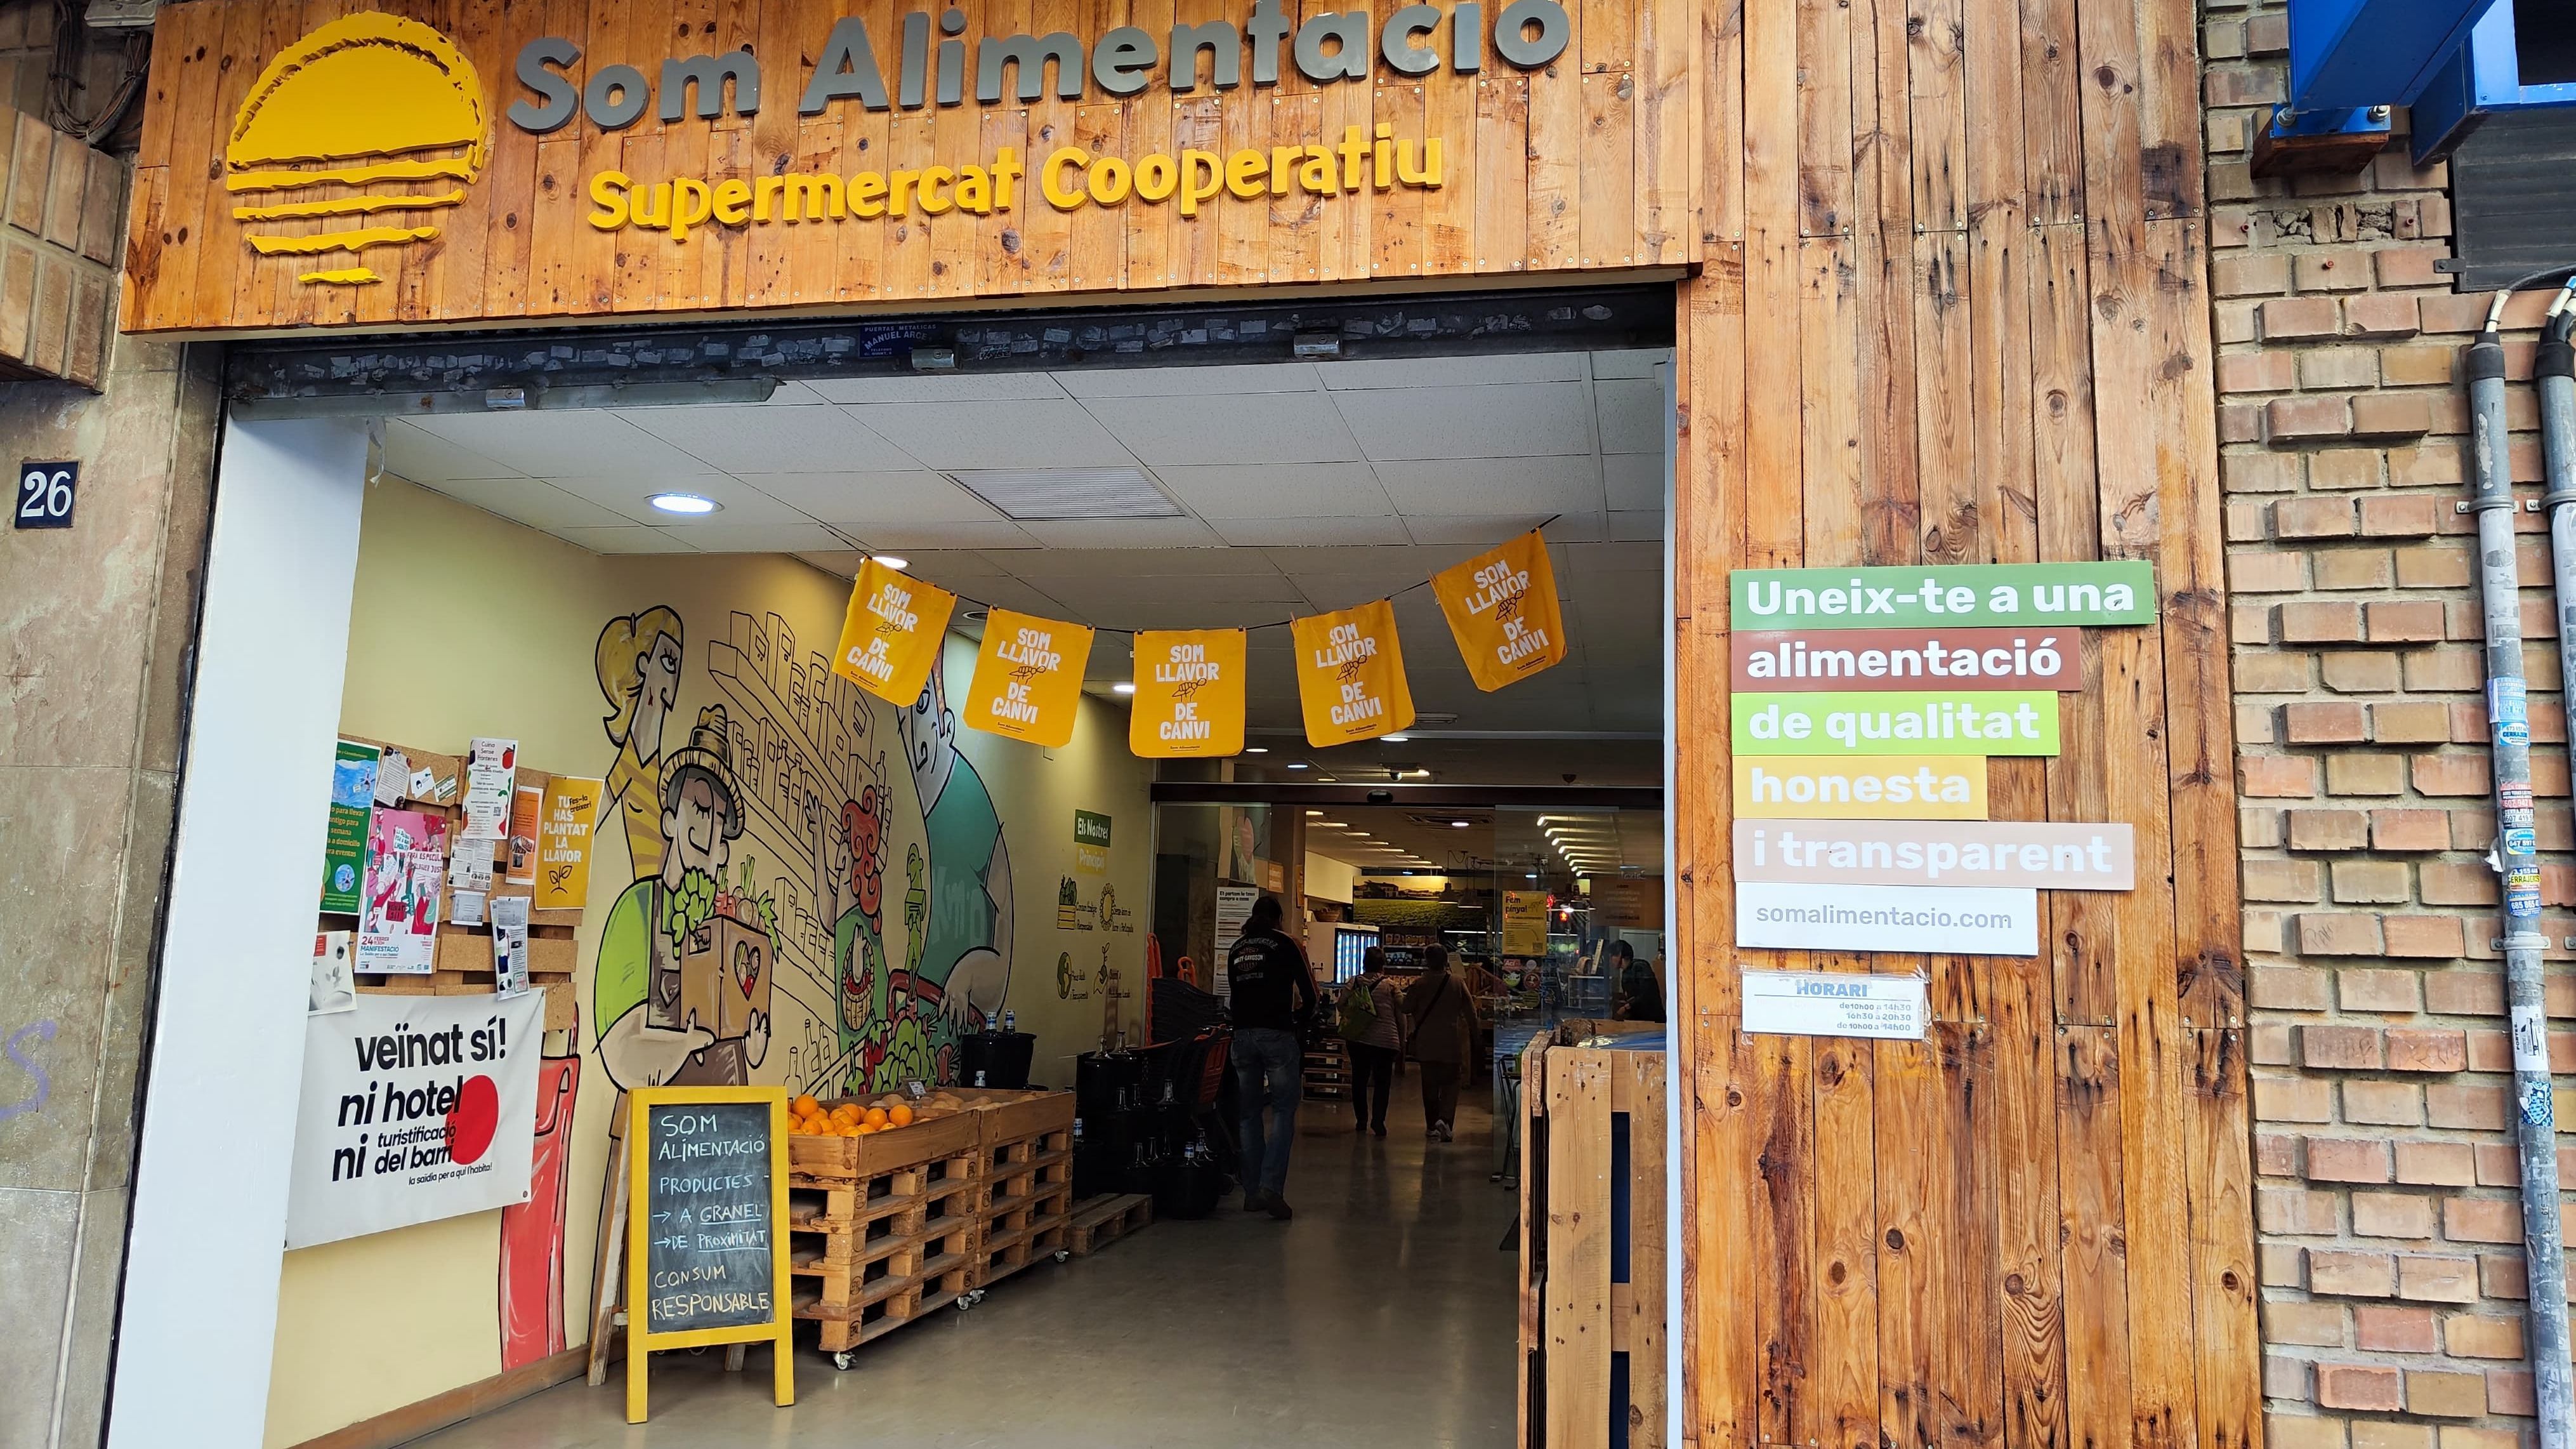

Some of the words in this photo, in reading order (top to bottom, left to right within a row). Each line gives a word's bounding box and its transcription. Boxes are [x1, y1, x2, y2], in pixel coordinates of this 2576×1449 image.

[508, 36, 761, 134] Som
[588, 147, 1022, 242] Supermercat
[1042, 122, 1442, 218] Cooperatiu
[864, 331, 902, 349] MANUEL
[20, 470, 72, 518] 26
[1473, 559, 1513, 590] SOM
[883, 583, 912, 611] SOM
[1465, 570, 1530, 615] LLAVOR
[1746, 578, 1976, 616] Uneix-te
[1989, 585, 2018, 613] a
[2032, 583, 2135, 612] una
[866, 598, 919, 633] LLAVOR
[1017, 628, 1051, 651] SOM
[1329, 623, 1360, 647] SOM
[1502, 616, 1529, 641] DE
[867, 637, 890, 661] DE
[997, 640, 1060, 672] LLAVOR
[1169, 644, 1204, 663] SOM
[1315, 637, 1377, 668] LLAVOR
[1497, 628, 1549, 665] CANVI
[1747, 637, 2062, 678] alimentació
[846, 645, 894, 684] CANVI
[1155, 662, 1219, 682] LLAVOR
[1007, 682, 1028, 702] DE
[1341, 682, 1366, 703] DE
[990, 697, 1038, 724] CANVI
[1174, 702, 1197, 721] DE
[1330, 697, 1383, 725] CANVI
[1159, 720, 1211, 739] CANVI
[1748, 704, 1812, 739] de
[1825, 703, 2040, 748] qualitat
[1750, 767, 1970, 804] honesta
[558, 795, 571, 808] TU
[553, 808, 574, 822] HAS
[544, 821, 589, 836] PLANTAT
[1077, 817, 1086, 835] Els
[1087, 818, 1108, 840] Nostres
[555, 836, 568, 849] LA
[1753, 830, 1766, 866] i
[1778, 831, 2113, 879] transparent
[543, 849, 582, 863] LLAVOR
[1506, 905, 1528, 913] pinya!
[1756, 904, 2013, 930] somalimentacio.com
[2511, 901, 2523, 910] 685
[361, 936, 373, 945] 24
[1796, 979, 1868, 997] HORARI
[1881, 1022, 1911, 1031] 14h00
[1882, 1013, 1912, 1021] 20h30
[355, 1022, 463, 1071] veïnat
[470, 1014, 506, 1062] sí!
[338, 1081, 378, 1127] ni
[382, 1075, 463, 1123] hotel
[378, 1120, 456, 1148] turistificació
[660, 1114, 718, 1137] SOM
[332, 1134, 368, 1182] ni
[374, 1146, 407, 1175] del
[409, 1137, 454, 1170] barri
[409, 1176, 415, 1185] la
[438, 1171, 449, 1183] per
[456, 1168, 466, 1180] qui
[660, 1174, 753, 1196] PRODUCTES
[679, 1208, 693, 1224] A
[699, 1203, 763, 1223] GRANEL
[671, 1235, 689, 1251] DE
[654, 1265, 726, 1289] CONSUM
[652, 1292, 770, 1321] RESPONSABLE
